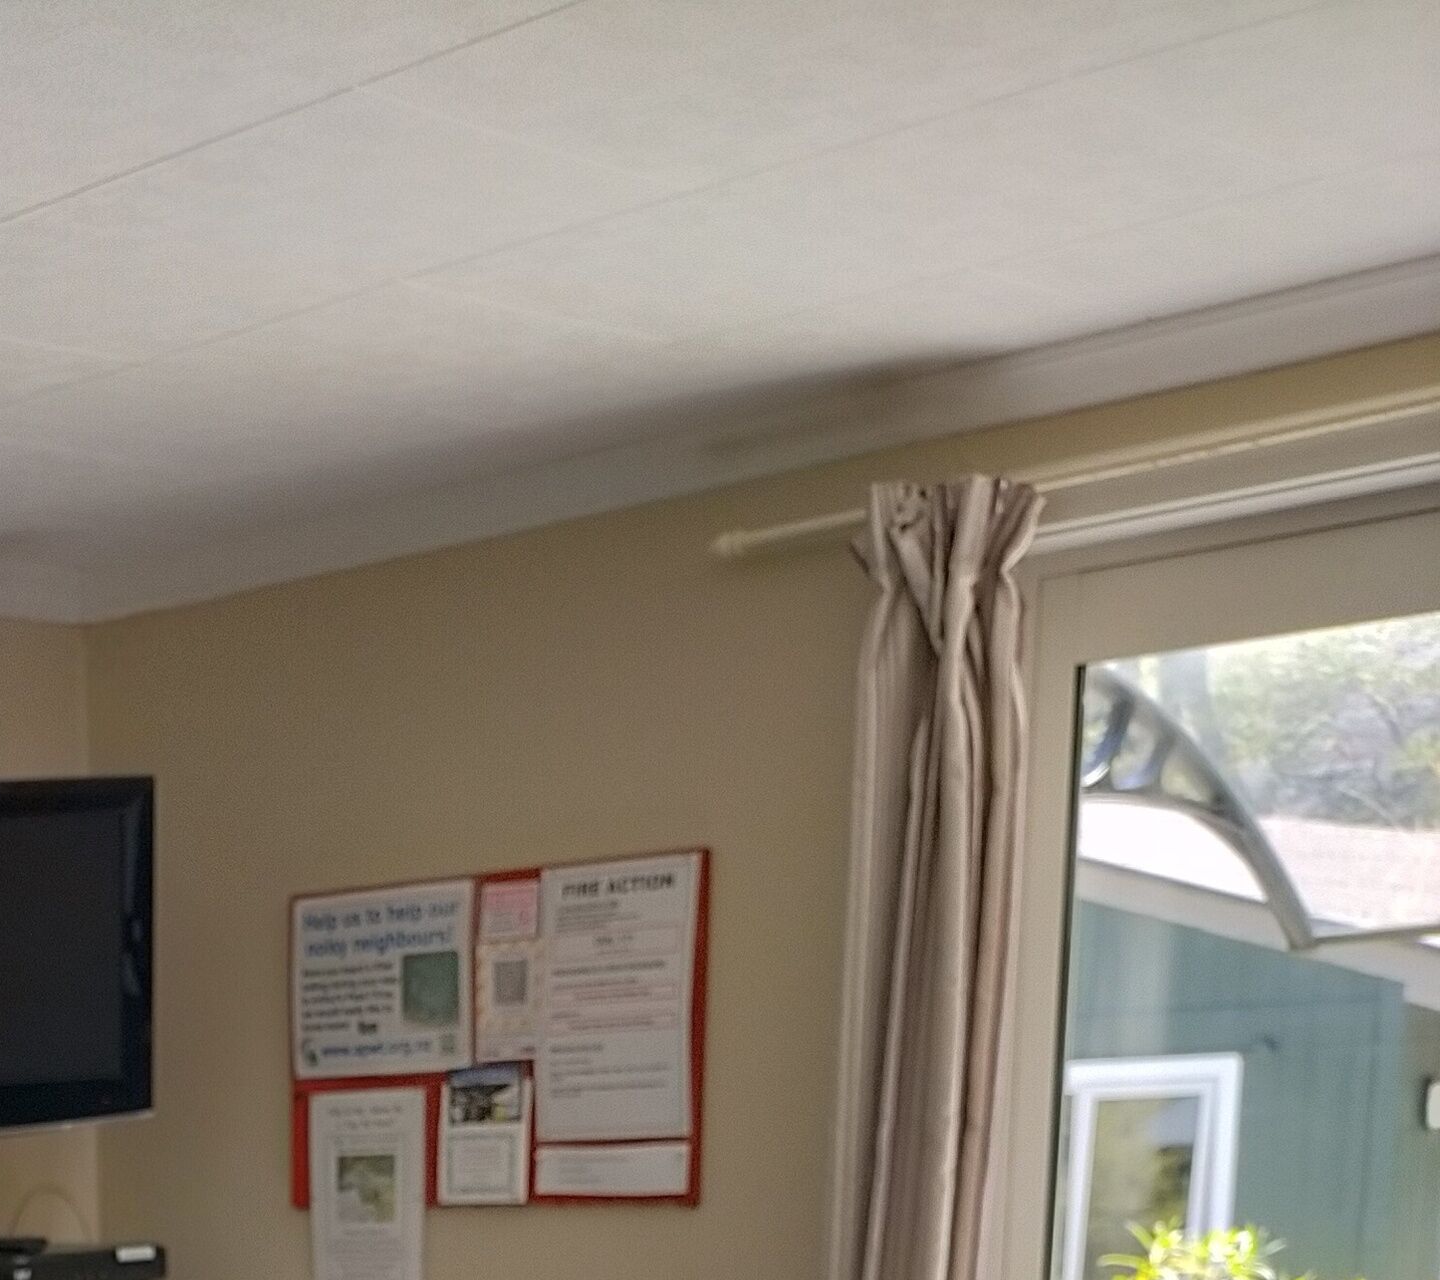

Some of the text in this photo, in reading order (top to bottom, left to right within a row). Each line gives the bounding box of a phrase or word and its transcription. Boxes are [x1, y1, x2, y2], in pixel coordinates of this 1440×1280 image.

[561, 873, 675, 898] FIRE ACTION
[302, 902, 459, 932] Help us to help our
